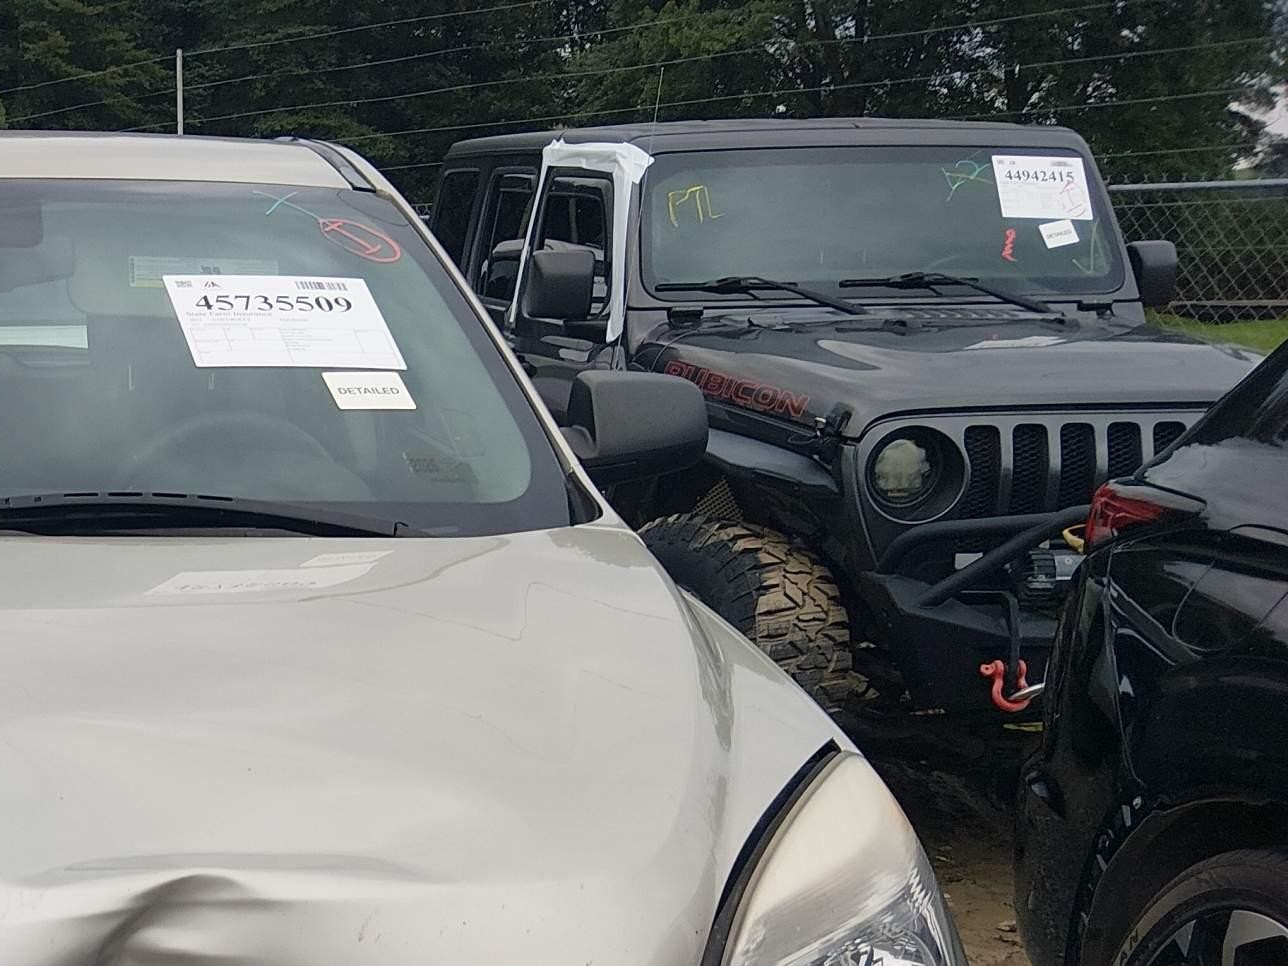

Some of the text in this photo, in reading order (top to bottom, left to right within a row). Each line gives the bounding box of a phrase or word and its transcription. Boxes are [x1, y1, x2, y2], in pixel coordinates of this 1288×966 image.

[1004, 169, 1075, 184] 44942415
[195, 294, 352, 313] 45735509
[337, 387, 400, 396] DETAILED
[665, 360, 809, 417] RUBICON
